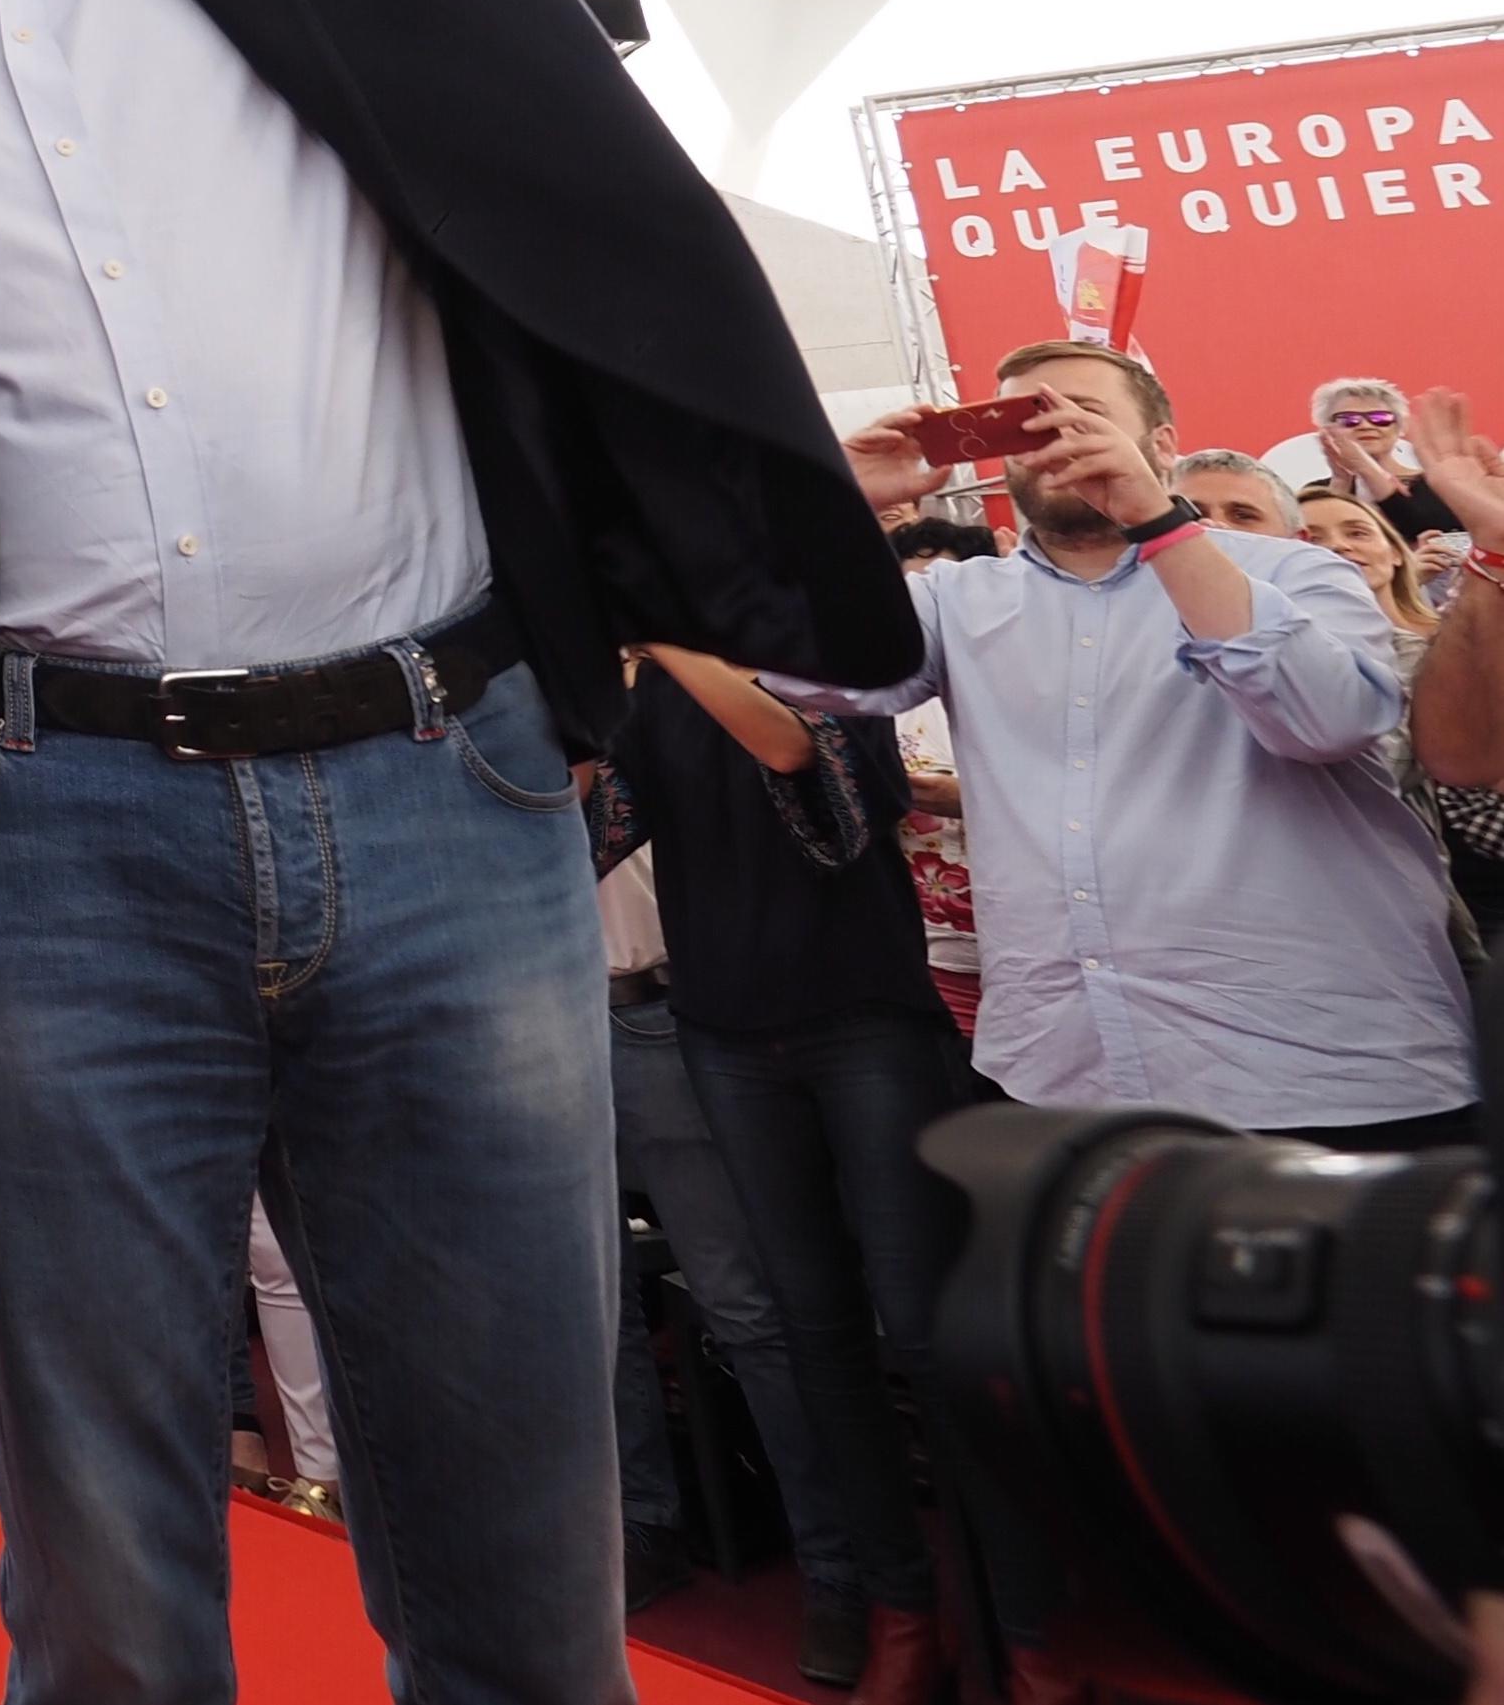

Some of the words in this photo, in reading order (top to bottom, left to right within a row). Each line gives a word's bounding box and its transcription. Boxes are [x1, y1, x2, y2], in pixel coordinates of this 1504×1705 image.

[935, 149, 1046, 200] LA
[1095, 98, 1493, 182] EUROPA
[951, 200, 1120, 258] QUE
[1180, 163, 1491, 234] QUIER
